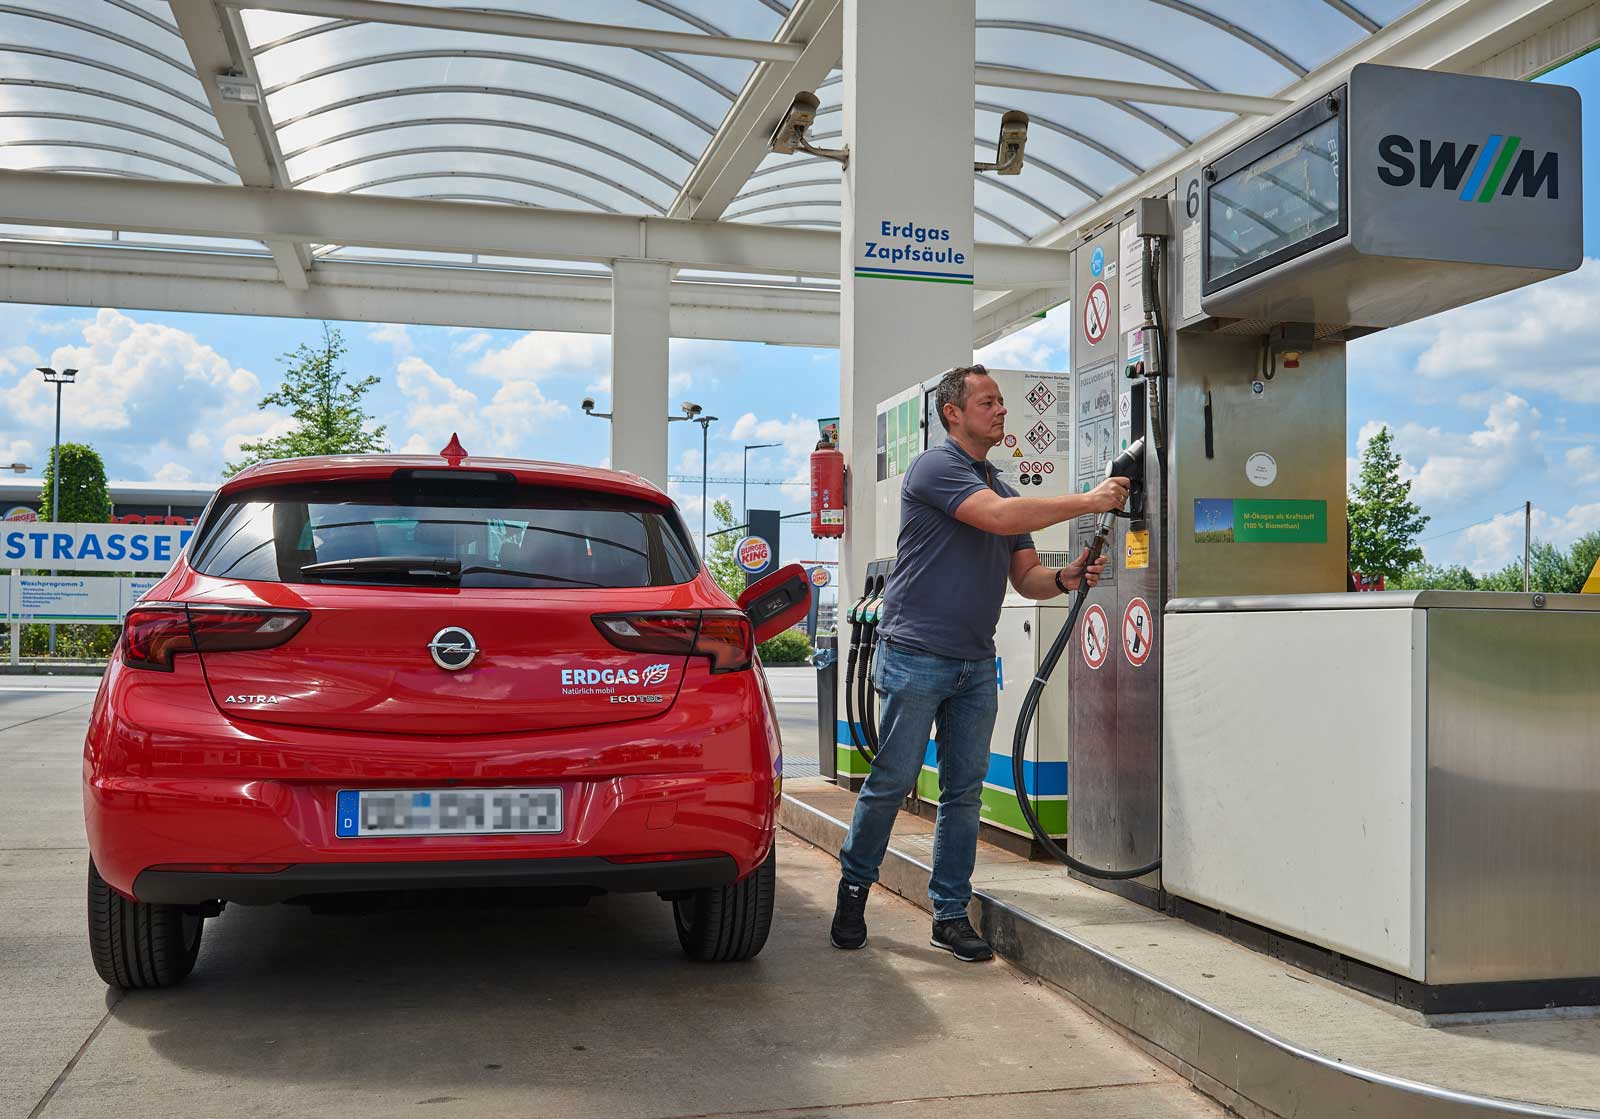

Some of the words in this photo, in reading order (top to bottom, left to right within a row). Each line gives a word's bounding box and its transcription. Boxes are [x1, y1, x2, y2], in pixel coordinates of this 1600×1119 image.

[1186, 178, 1200, 219] 6
[881, 220, 950, 243] Erdgas
[864, 242, 965, 265] Zapfsäule
[740, 543, 768, 555] BURGER
[741, 549, 768, 564] KING
[561, 669, 640, 685] ERDGAS
[562, 687, 595, 695] Natürlich
[595, 687, 615, 695] mobil
[225, 695, 279, 704] ASTRA
[609, 694, 663, 704] ECOTEC
[343, 817, 353, 829] D
